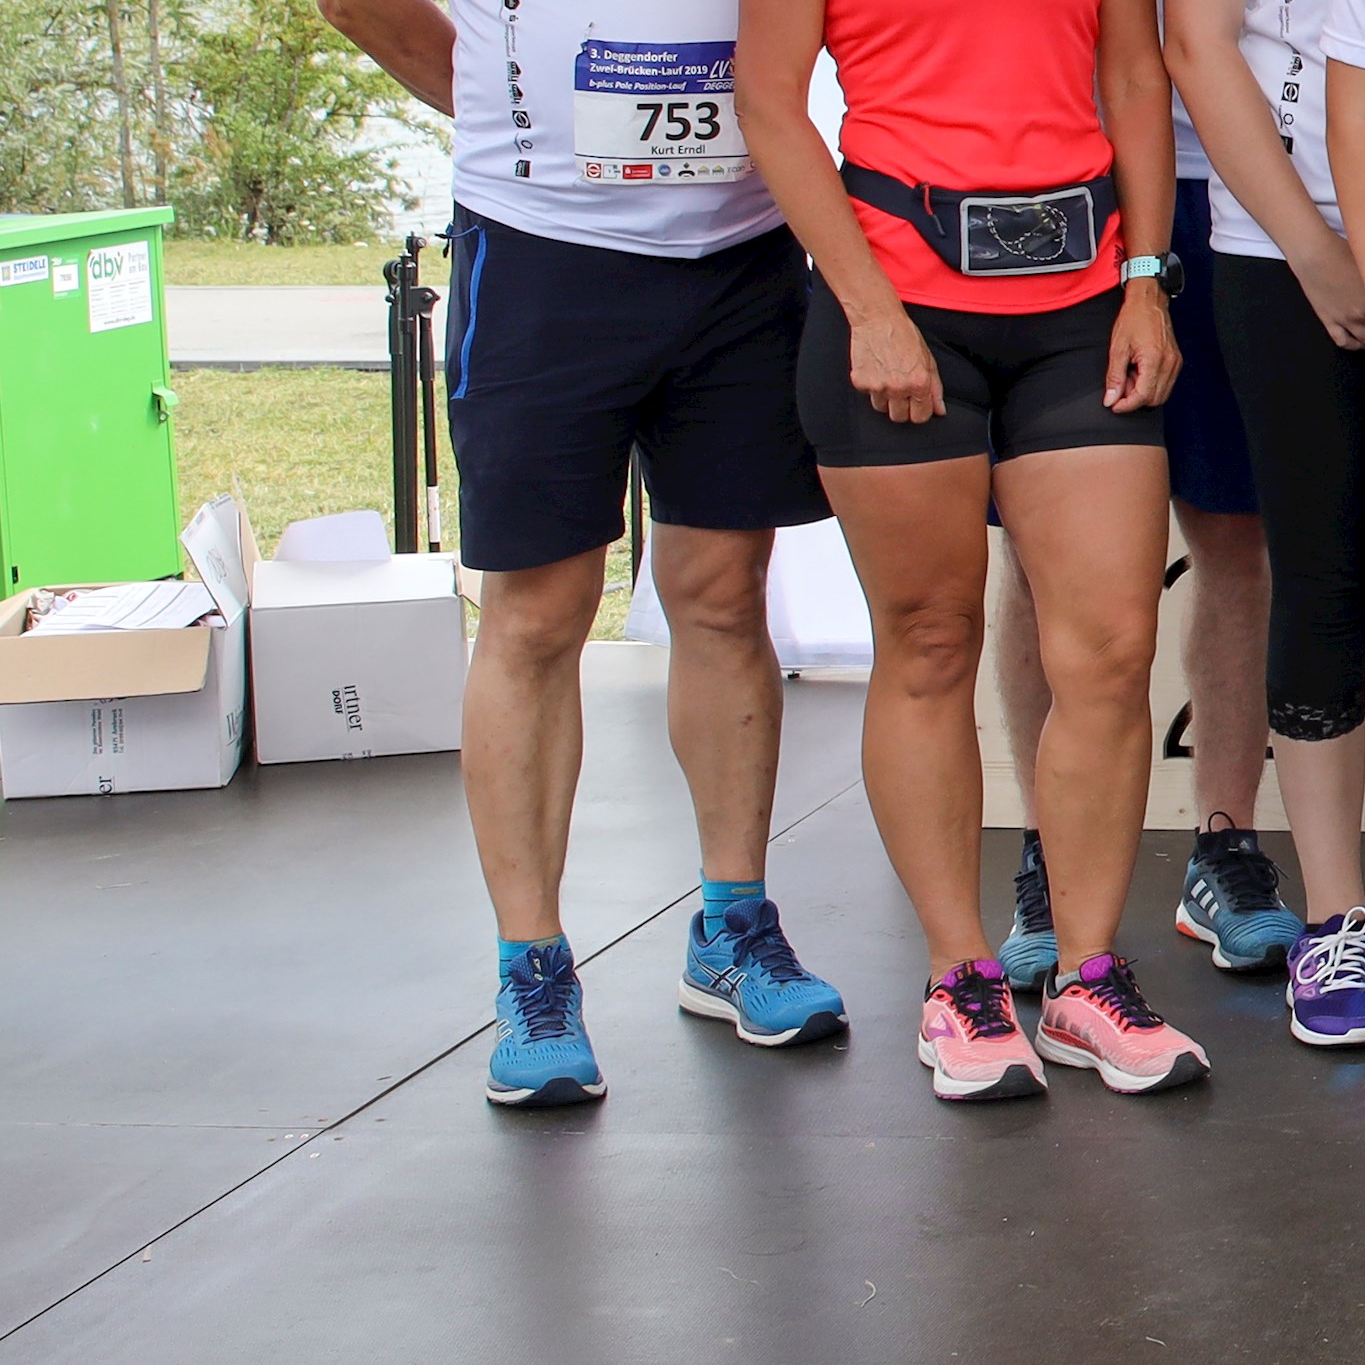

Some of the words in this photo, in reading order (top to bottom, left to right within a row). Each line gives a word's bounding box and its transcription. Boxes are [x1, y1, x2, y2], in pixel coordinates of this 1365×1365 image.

[590, 48, 601, 59] 3.
[603, 49, 678, 63] Deggendorfer
[589, 63, 683, 76] Zwei-Brücken-Lauf
[684, 65, 708, 75] 2019
[709, 60, 729, 79] LV
[588, 79, 614, 88] b-plus
[614, 80, 634, 90] Pole
[634, 82, 687, 91] Position-Lauf
[636, 101, 721, 141] 753
[651, 145, 675, 155] Kurt
[677, 145, 706, 155] Erndl
